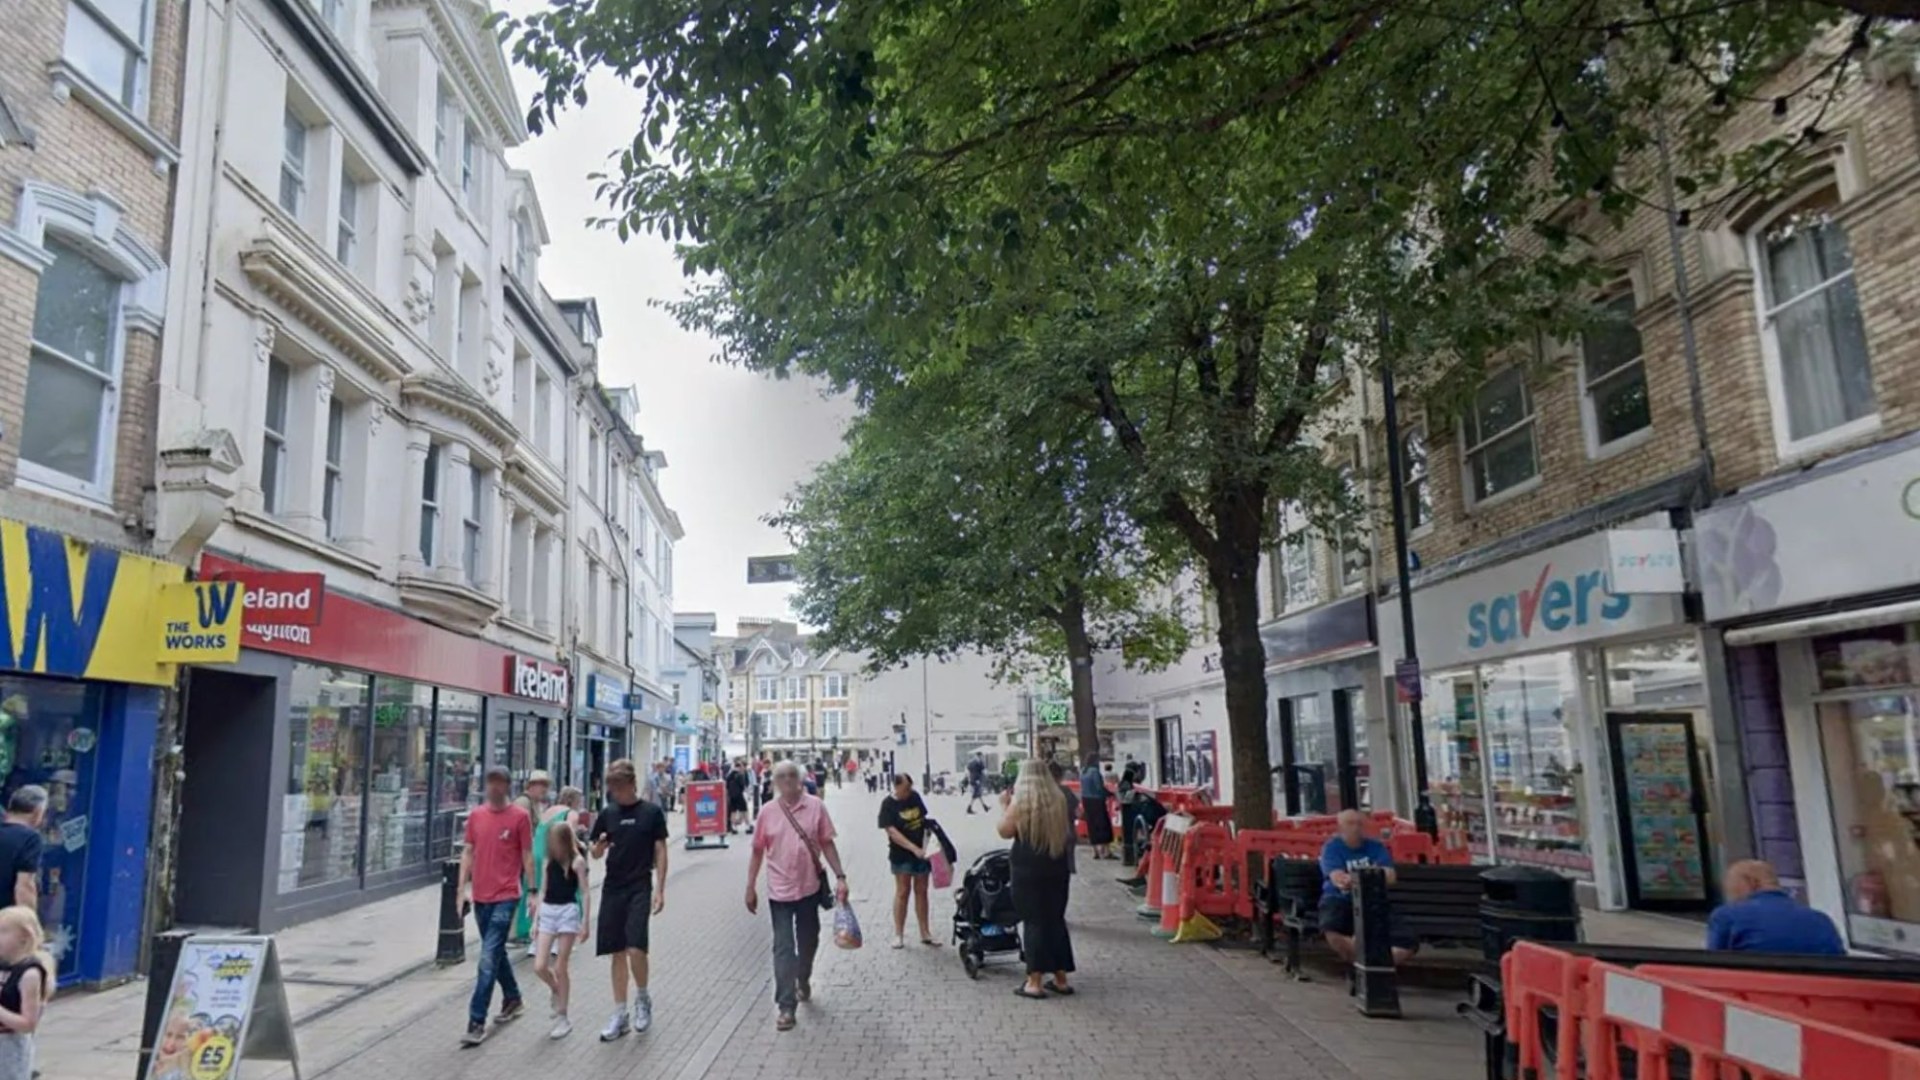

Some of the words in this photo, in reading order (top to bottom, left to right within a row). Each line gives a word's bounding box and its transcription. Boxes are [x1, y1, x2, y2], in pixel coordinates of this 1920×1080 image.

[243, 587, 311, 610] eland
[166, 621, 190, 633] THE
[166, 634, 227, 650] WORKS
[514, 654, 568, 706] Iceland
[200, 1045, 225, 1066] £5
